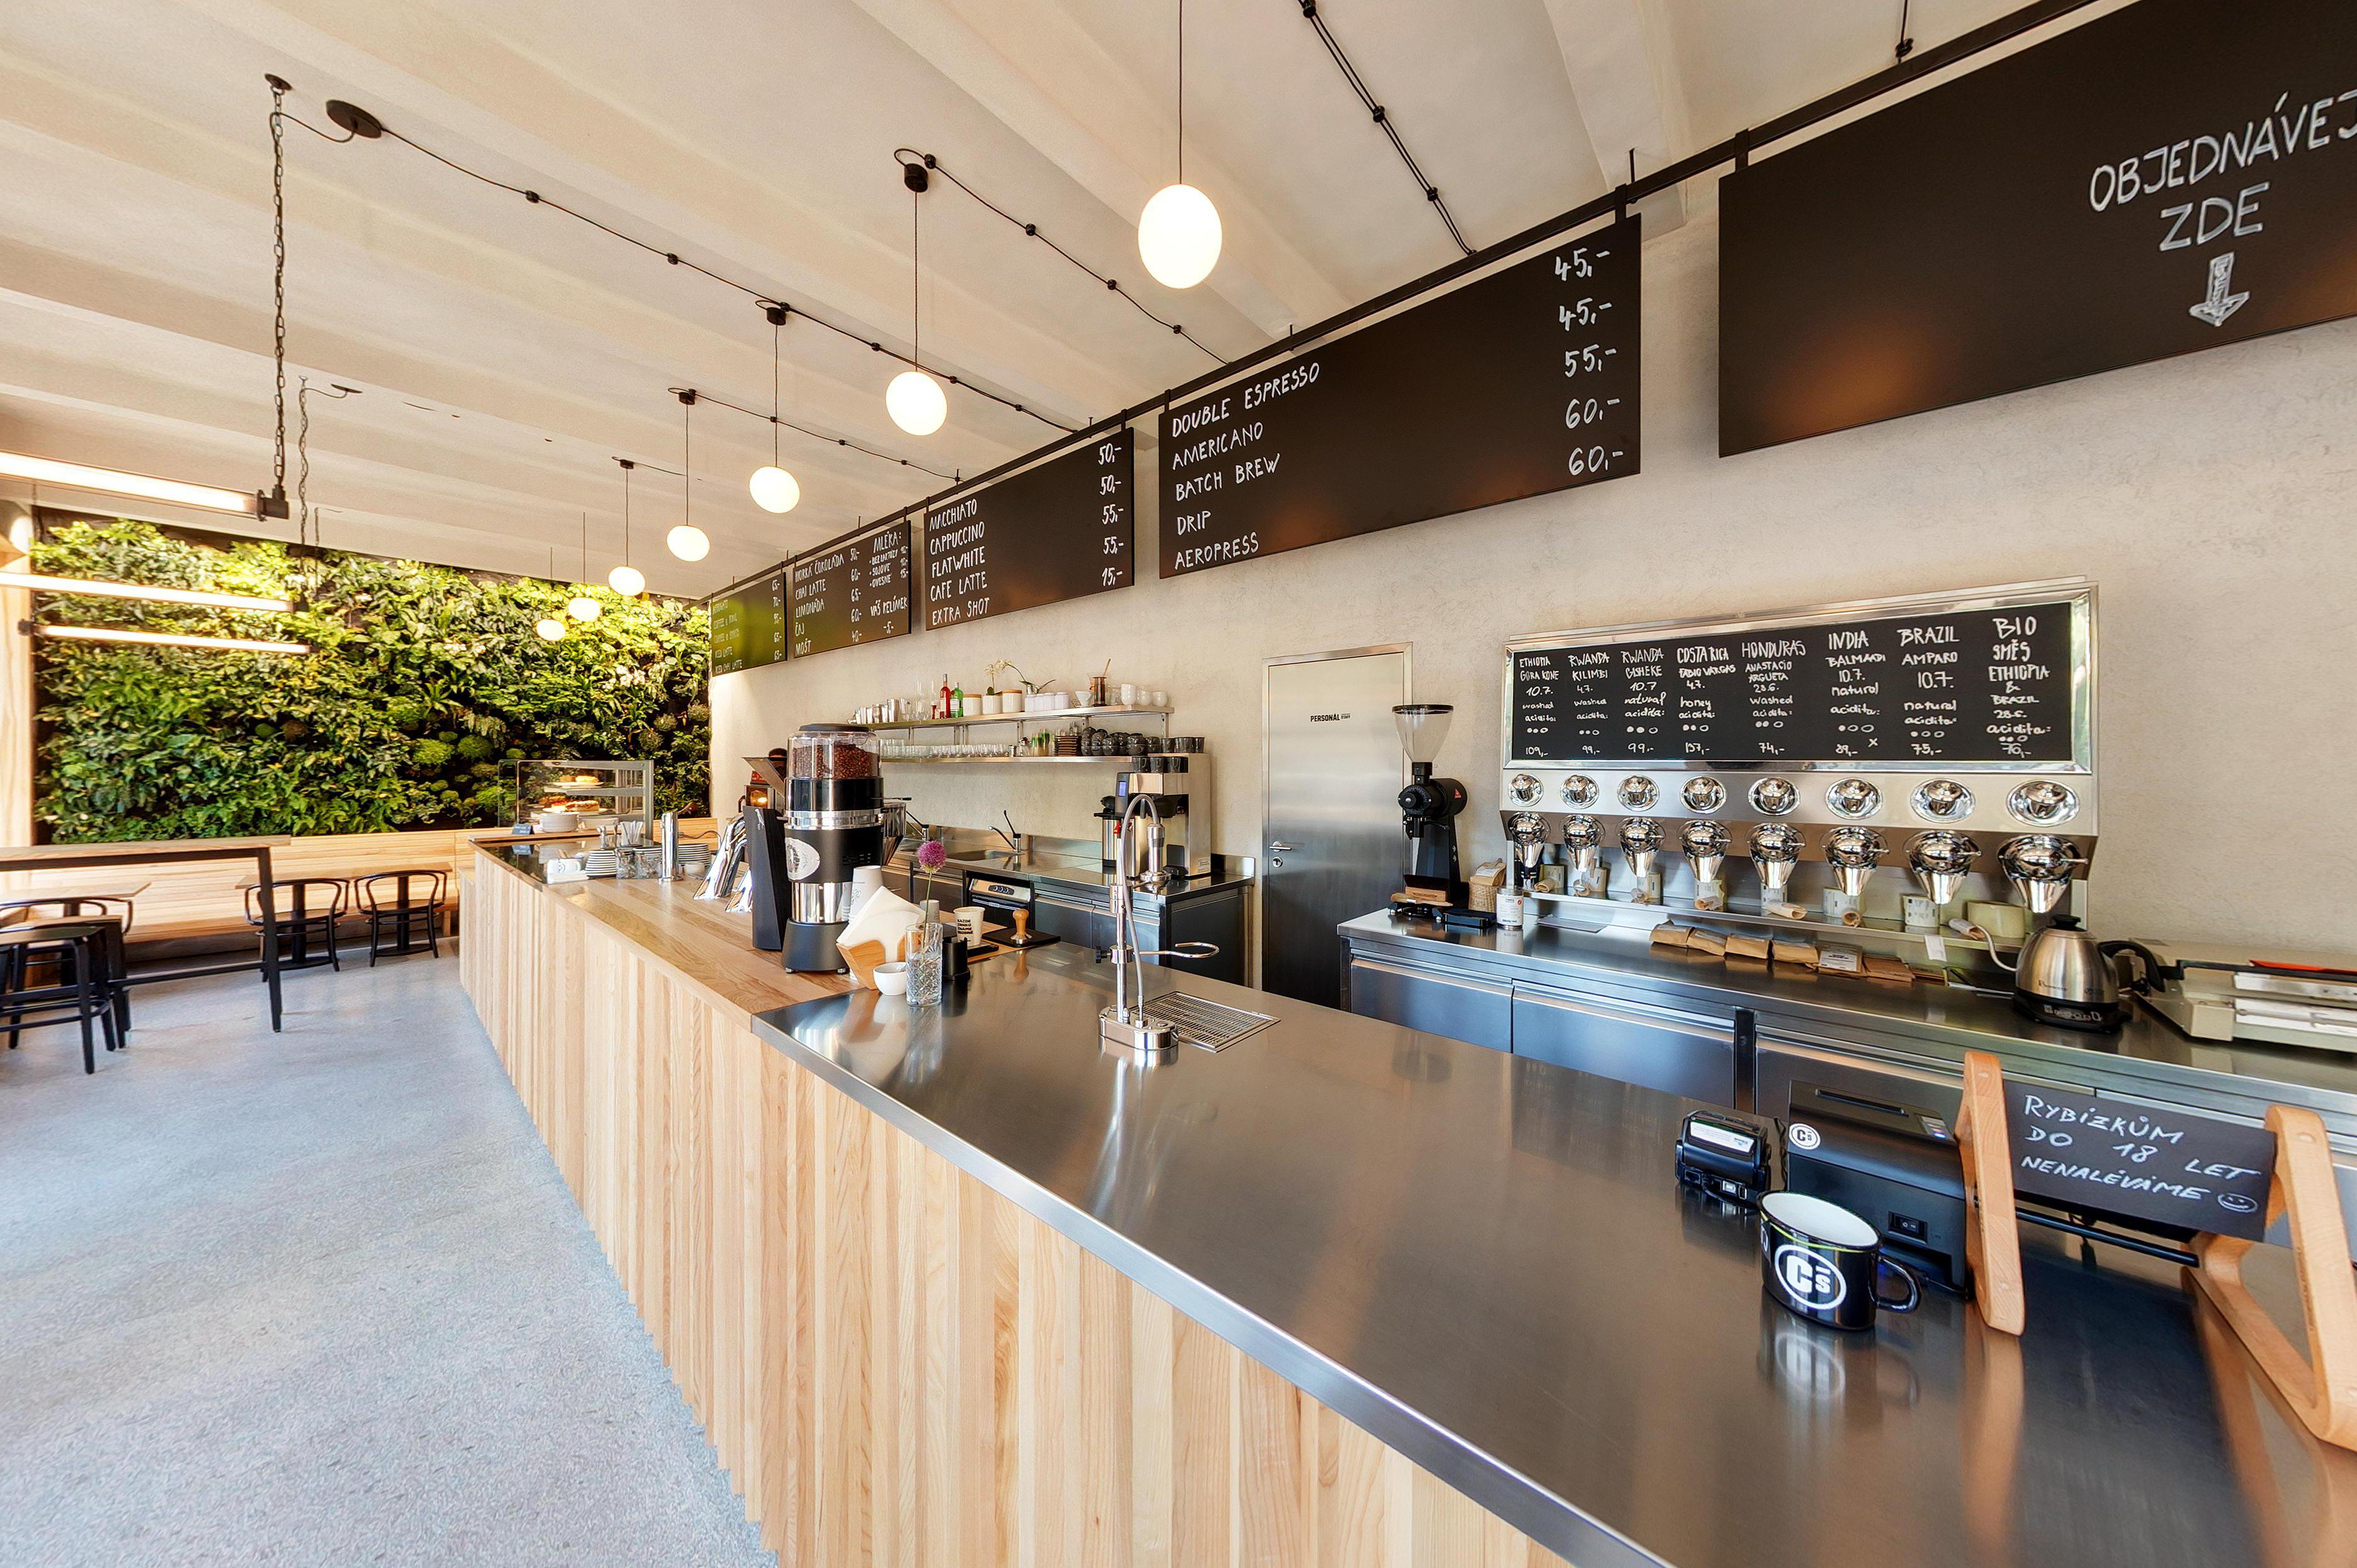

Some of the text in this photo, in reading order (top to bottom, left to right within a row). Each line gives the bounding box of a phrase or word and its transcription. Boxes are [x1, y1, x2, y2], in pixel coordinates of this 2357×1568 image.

[2159, 182, 2269, 251] ZDE
[1555, 248, 1610, 281] 45,-
[1559, 298, 1612, 331] 45,-
[1565, 344, 1616, 377] 55,-
[1173, 362, 1320, 437] DOUBLE ESPRESSO
[1566, 398, 1620, 429] 60,-
[1099, 443, 1121, 465] 50,-
[1173, 420, 1263, 471] AMERICANO
[1569, 446, 1623, 475] 60,-
[1100, 475, 1121, 495] 50,-
[1177, 453, 1280, 501] BATCH BREW
[929, 499, 977, 532] MACCHIATO
[1102, 504, 1124, 524] 55,-
[1177, 511, 1211, 535] DRIP
[930, 521, 985, 556] CAPPUCCINO
[1104, 536, 1124, 554] 55,-
[1175, 531, 1259, 570] AEROPRESS
[931, 546, 986, 578] FLATWHITE
[810, 579, 826, 595] LATTE
[930, 572, 987, 601] CAFE LATTE
[1102, 568, 1122, 586] 15,-
[933, 597, 989, 626] EXTRA SHOT
[1897, 626, 1959, 646] BRAZIL
[1992, 616, 2036, 639] BIO
[796, 638, 811, 656] MOŠT
[1742, 640, 1806, 658] HONDURAS
[1829, 631, 1869, 650] INDIA
[1993, 639, 2030, 662] SMĚS
[1520, 657, 1551, 667] ETHIOPIA
[1568, 652, 1610, 667] RWANDA
[1620, 648, 1664, 663] RWANDA
[1677, 646, 1729, 663] COSTA RICA
[1902, 652, 1957, 665] AMPARO
[1573, 669, 1607, 681] KILIMBI
[1625, 665, 1662, 679] GISHEKE
[1989, 664, 2050, 682] ETHIOPIA
[1832, 682, 1878, 696] natural
[1681, 696, 1711, 711] honey
[1749, 695, 1793, 704] washed
[1904, 700, 1956, 711] natural
[1991, 695, 2039, 704] BRAZIL
[1628, 743, 1653, 753] 99,-
[2026, 1125, 2260, 1179] DO 18 LET
